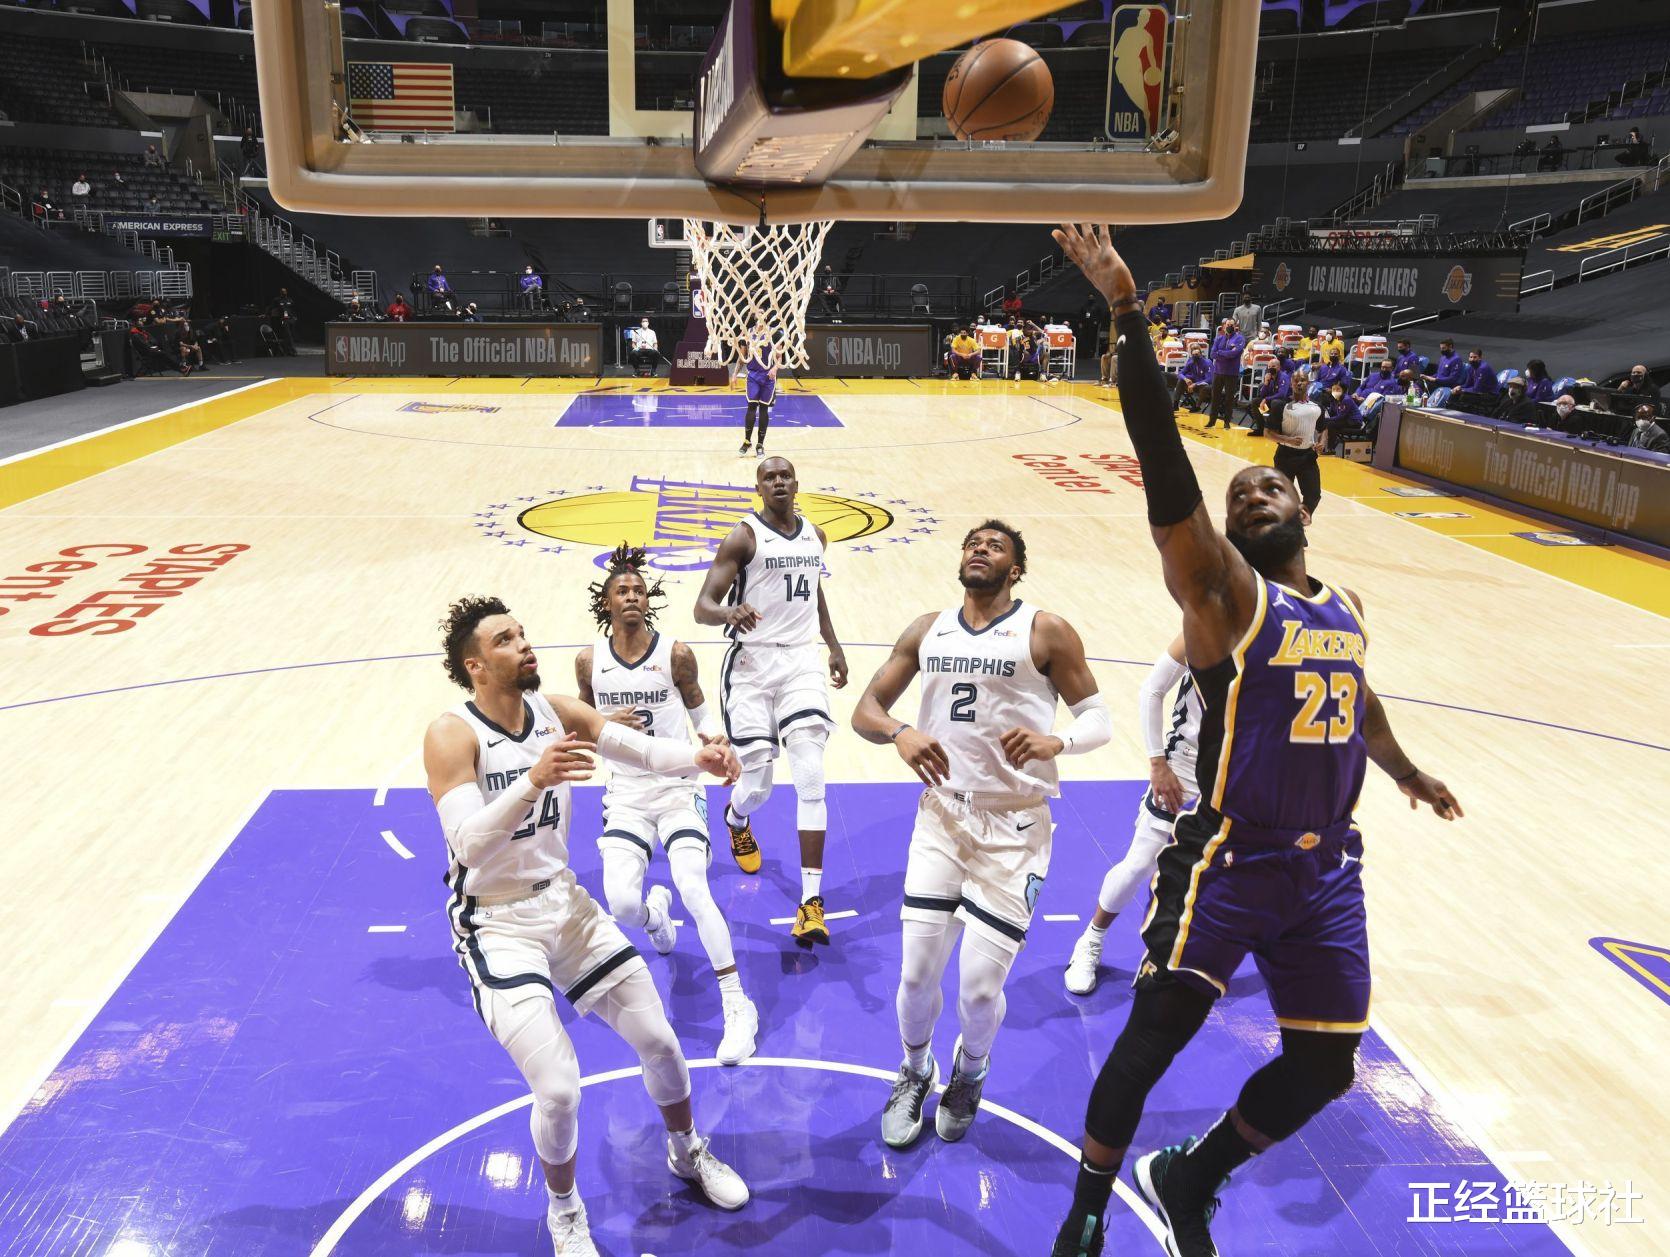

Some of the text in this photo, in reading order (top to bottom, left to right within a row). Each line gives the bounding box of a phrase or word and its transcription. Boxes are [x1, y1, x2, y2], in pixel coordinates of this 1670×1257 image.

[1114, 112, 1139, 132] NBA
[112, 221, 204, 231] AMERICAN EXPRESS
[213, 232, 230, 241] EXIT
[1308, 265, 1326, 291] LOS
[1327, 266, 1372, 295] ANGELES
[1373, 267, 1419, 298] LAKERS
[350, 336, 406, 367] NBA App
[430, 337, 590, 368] The Official NBA App
[990, 334, 998, 343] G
[1057, 334, 1065, 343] G
[841, 337, 901, 370] NBA App
[1413, 422, 1455, 479] NBA App
[1012, 453, 1116, 495] Center
[1483, 440, 1641, 530] The Official NBA App
[765, 555, 820, 569] MEMPHIS
[0, 543, 149, 617] Cent
[28, 543, 251, 637] STAPLES
[783, 574, 811, 601] 14
[994, 628, 1018, 638] FedEx
[1268, 619, 1366, 670] LAKERS
[643, 664, 662, 672] FedEx
[926, 656, 1016, 678] MEMPHIS
[598, 688, 669, 706] MEMPHIS
[950, 682, 978, 723] 2
[1289, 671, 1358, 745] 23
[534, 726, 558, 739] FedEx
